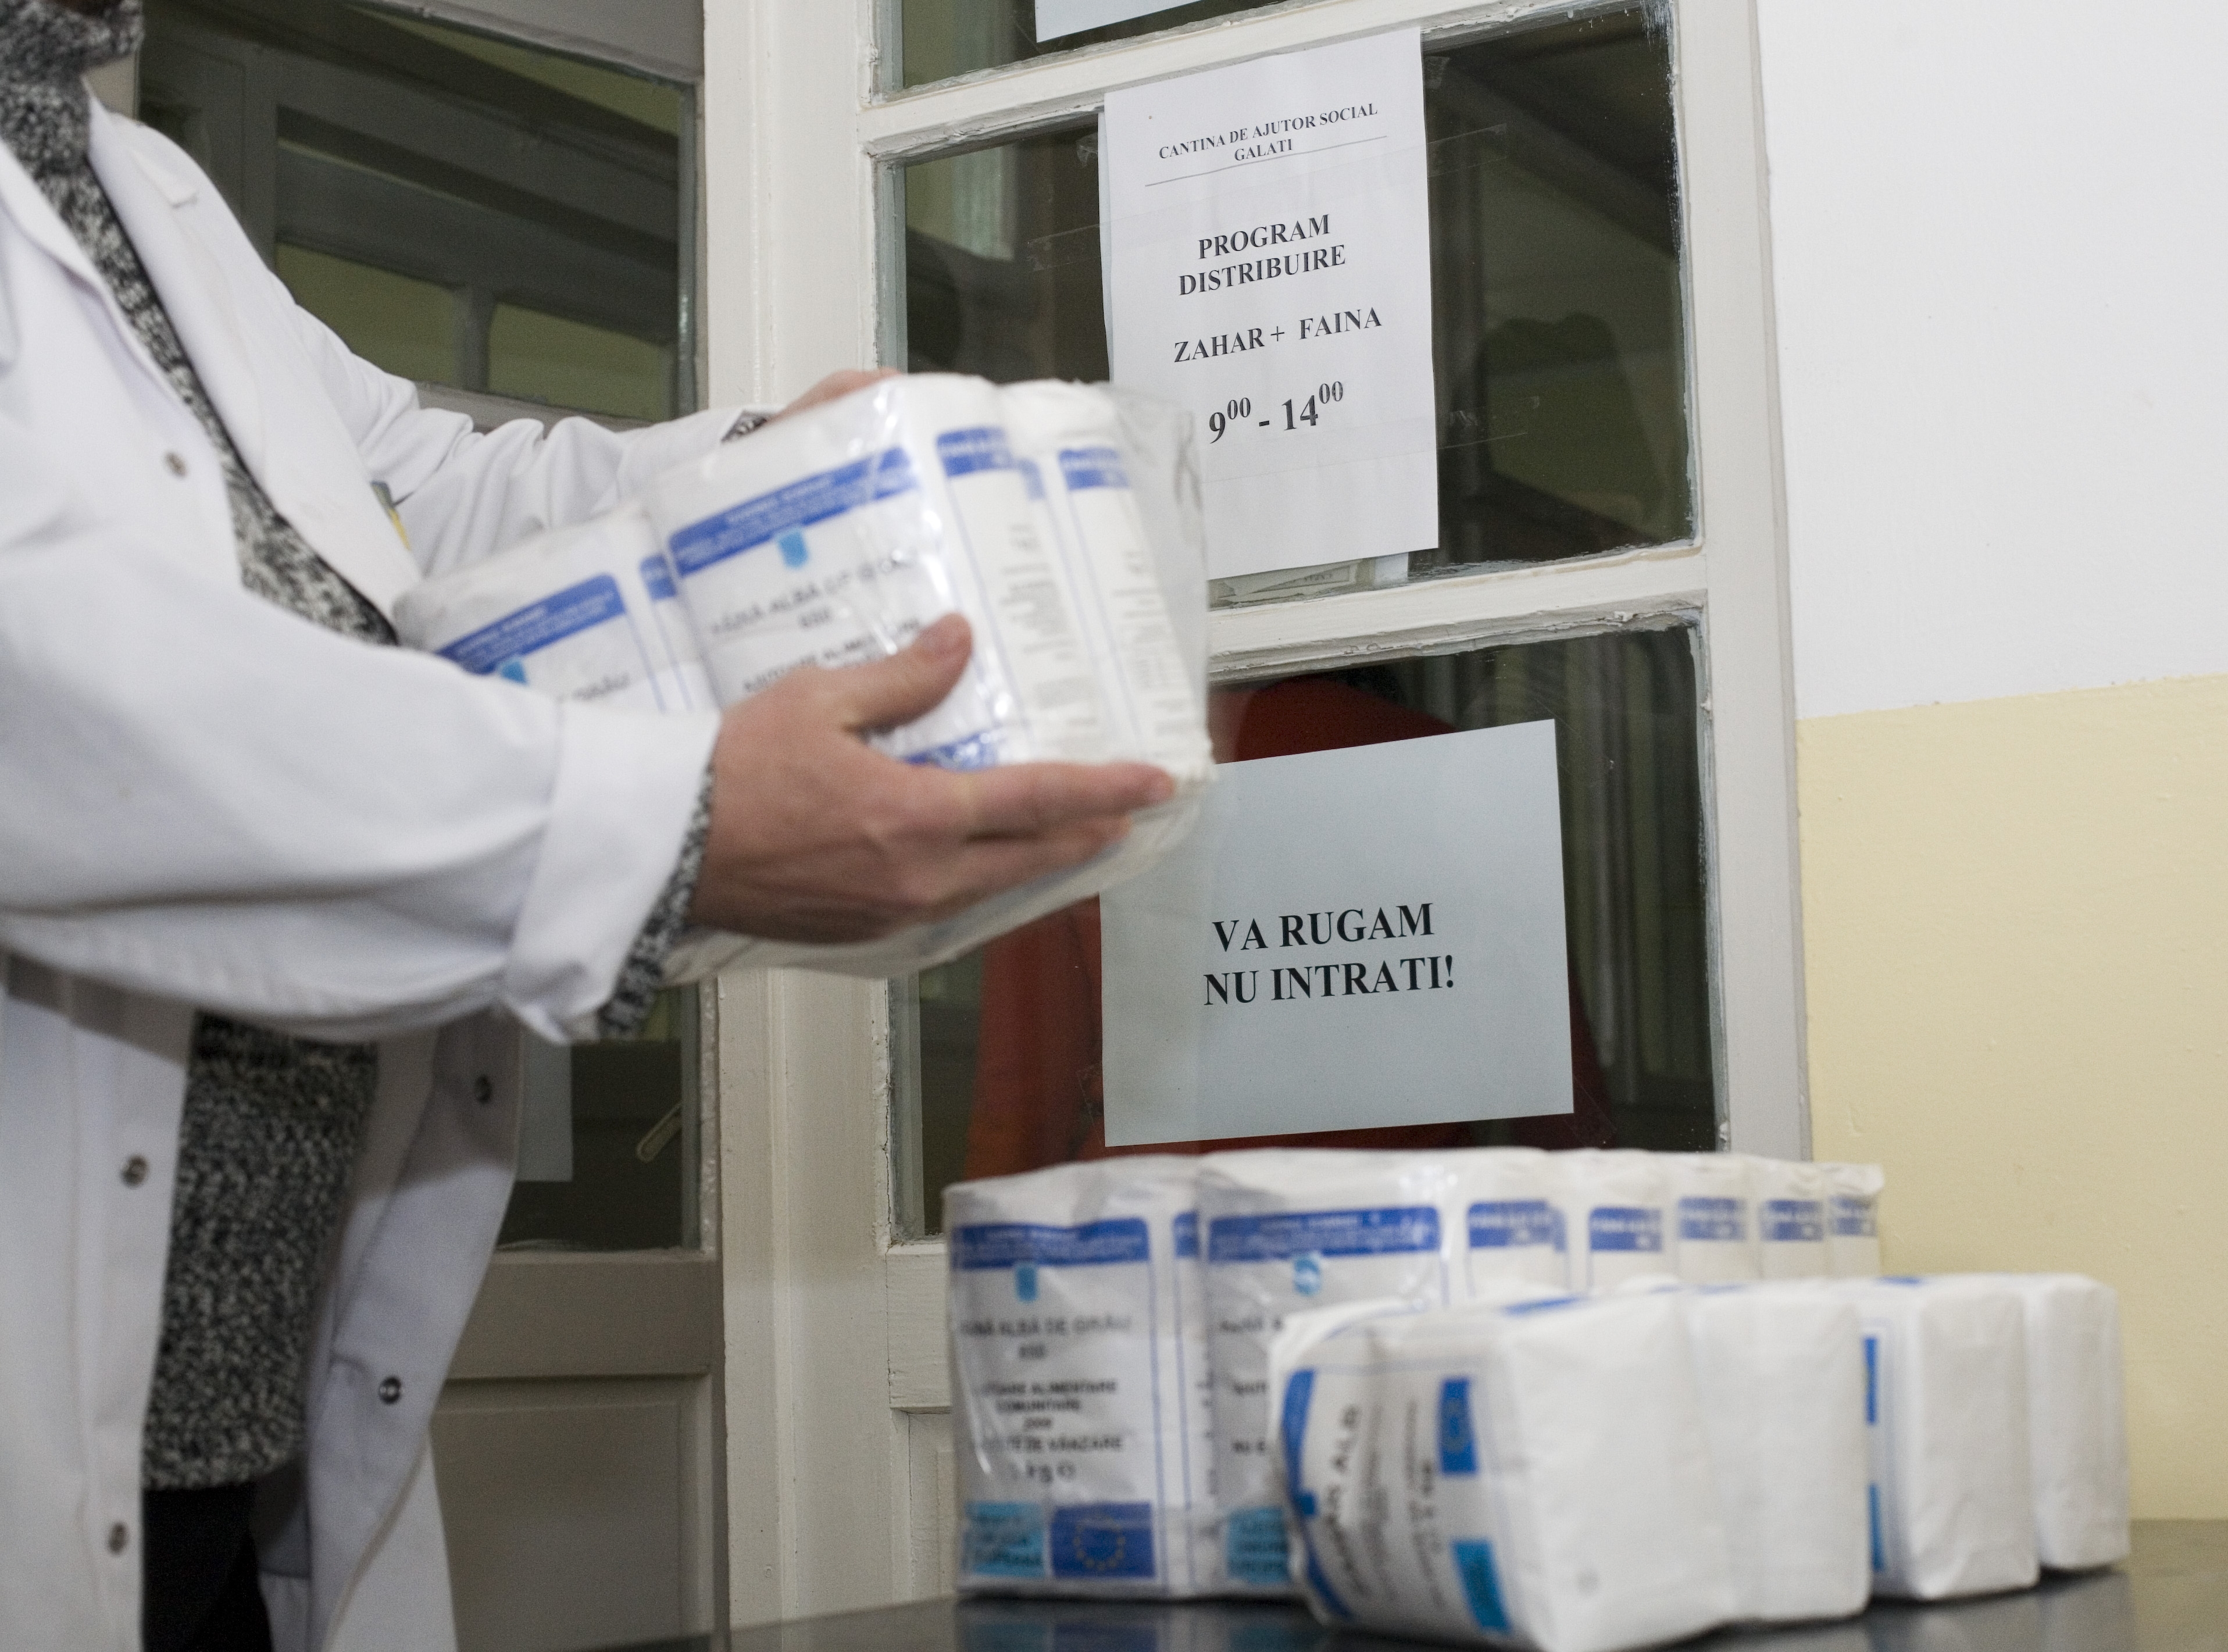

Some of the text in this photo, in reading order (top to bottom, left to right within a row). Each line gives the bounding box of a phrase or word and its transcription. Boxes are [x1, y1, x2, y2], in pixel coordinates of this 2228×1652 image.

[1159, 103, 1378, 159] CANTINA DE AJUTOR SOCIAL
[1234, 138, 1293, 162] GALATI
[1198, 214, 1330, 259] PROGRAM
[1179, 244, 1346, 296] DISTRIBUIRE
[1174, 327, 1265, 363] ZAHAR
[1299, 306, 1382, 340] FAINA
[1212, 902, 1435, 952] VA RUGAM
[1203, 954, 1454, 1006] NU INTRATI!
